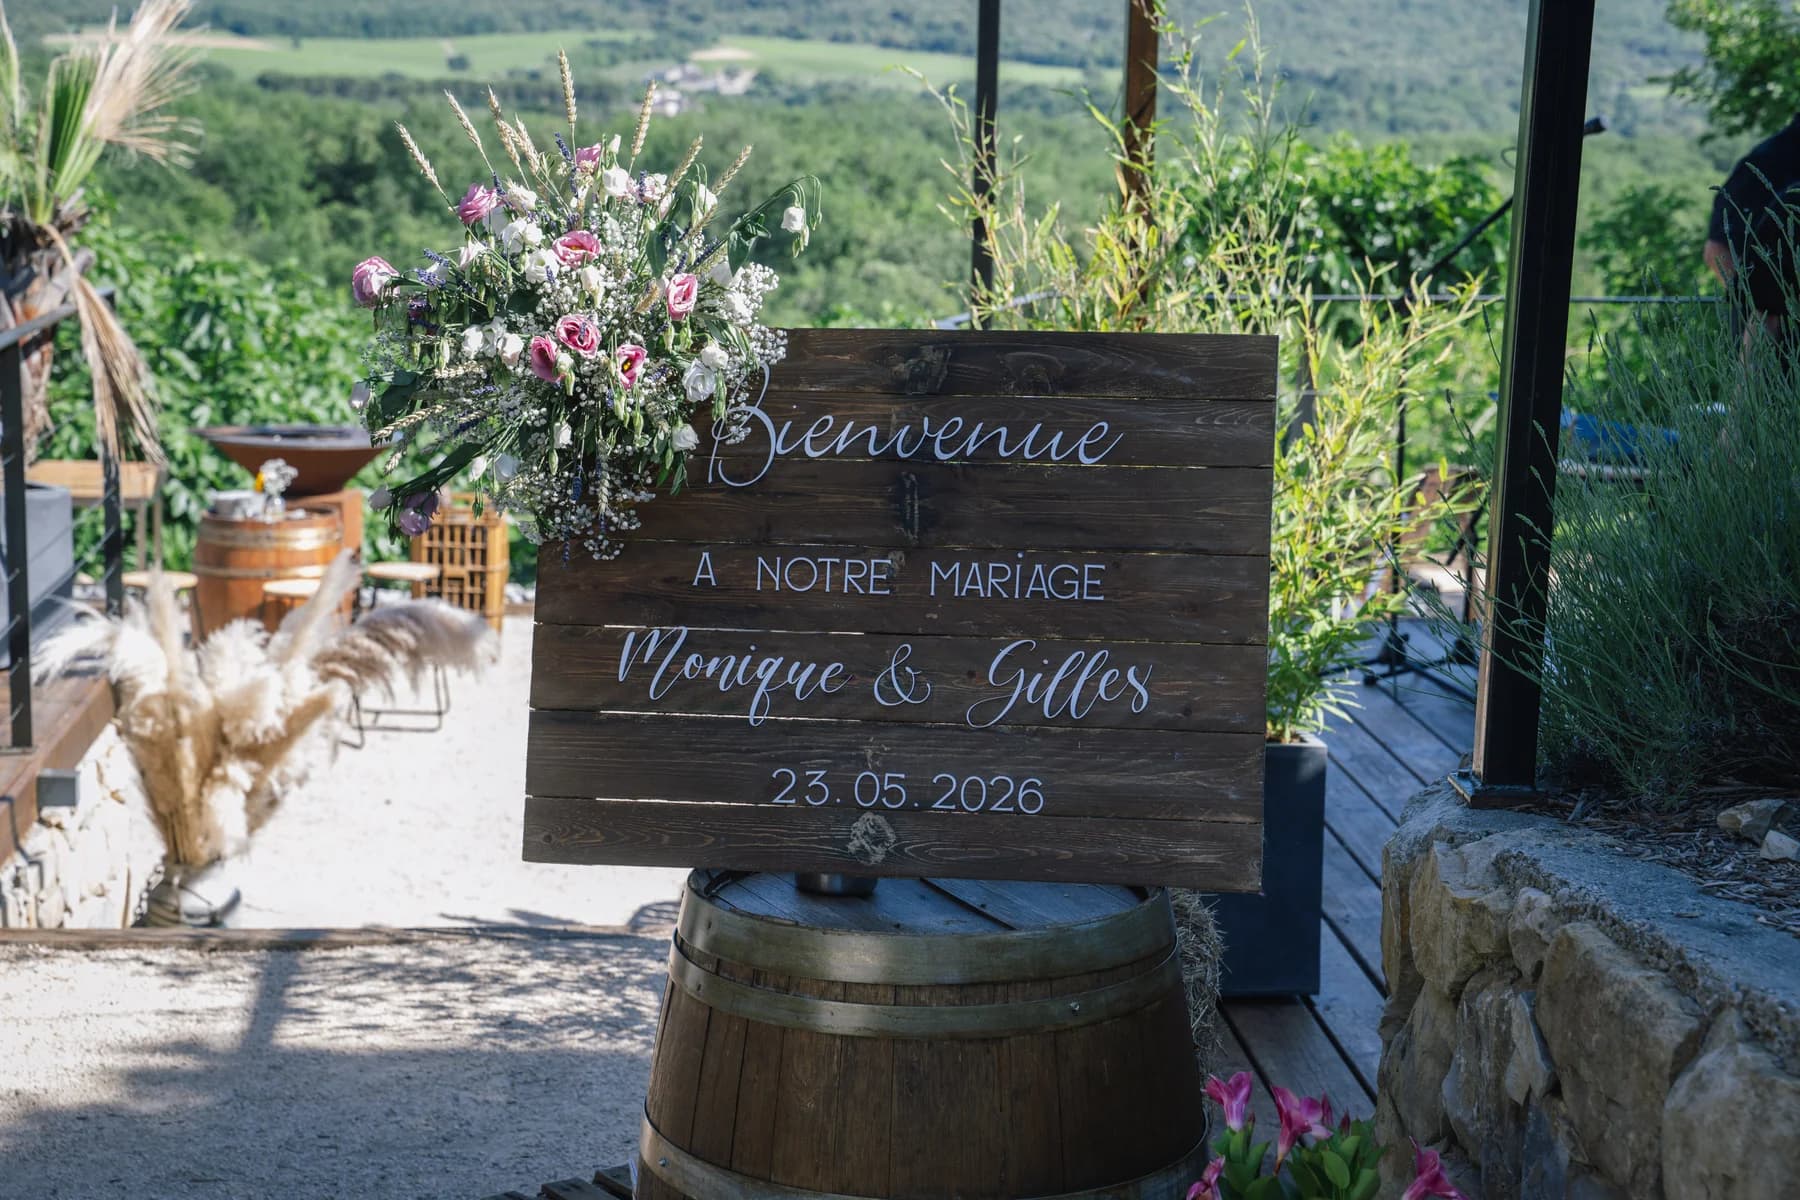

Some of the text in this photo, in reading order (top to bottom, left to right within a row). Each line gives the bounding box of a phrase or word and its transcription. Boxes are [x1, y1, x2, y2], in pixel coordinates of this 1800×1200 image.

[708, 362, 1124, 487] Bienvenue
[692, 552, 718, 588] A
[757, 557, 891, 595] NOTRE
[618, 626, 1153, 729] Monique & Gilles
